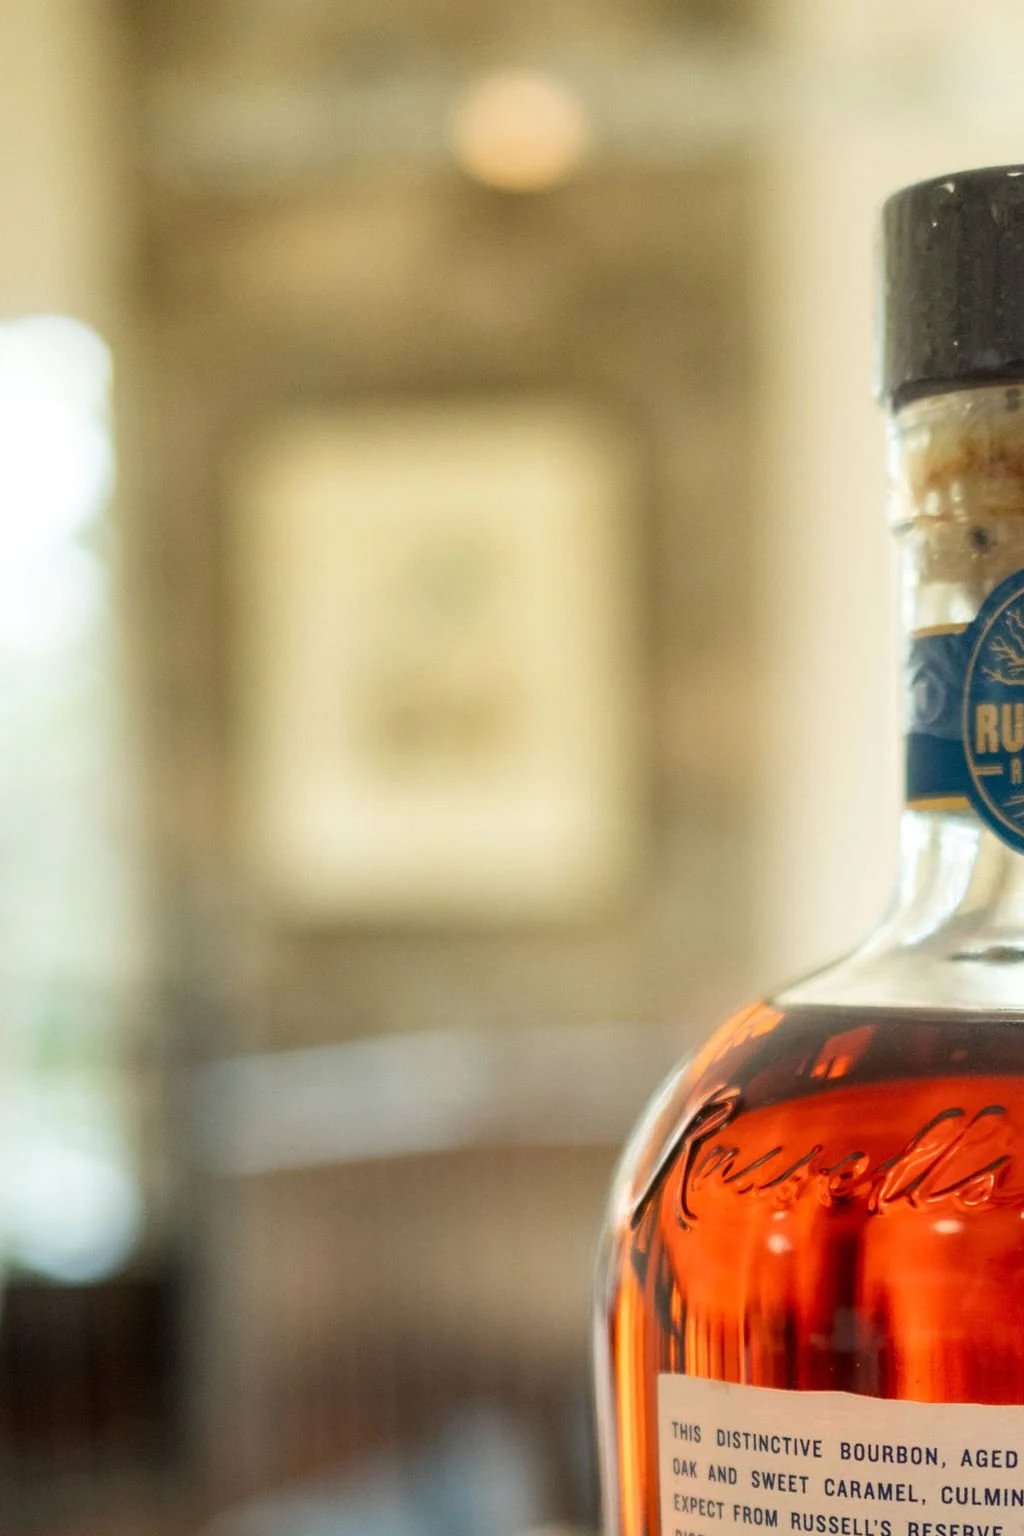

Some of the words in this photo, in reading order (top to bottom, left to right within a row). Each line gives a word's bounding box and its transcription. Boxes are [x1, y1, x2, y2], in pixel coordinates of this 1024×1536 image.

[672, 1421, 701, 1443] THIS
[717, 1428, 823, 1458] DISTINCTIVE
[840, 1442, 946, 1468] BOURBON,
[960, 1449, 1018, 1468] AGED
[673, 1457, 697, 1478] OAK
[708, 1464, 737, 1485] AND
[751, 1470, 809, 1494] SWEET
[824, 1478, 926, 1505] CARAMEL,
[674, 1493, 725, 1520] EXPECT
[733, 1504, 778, 1527] FROM
